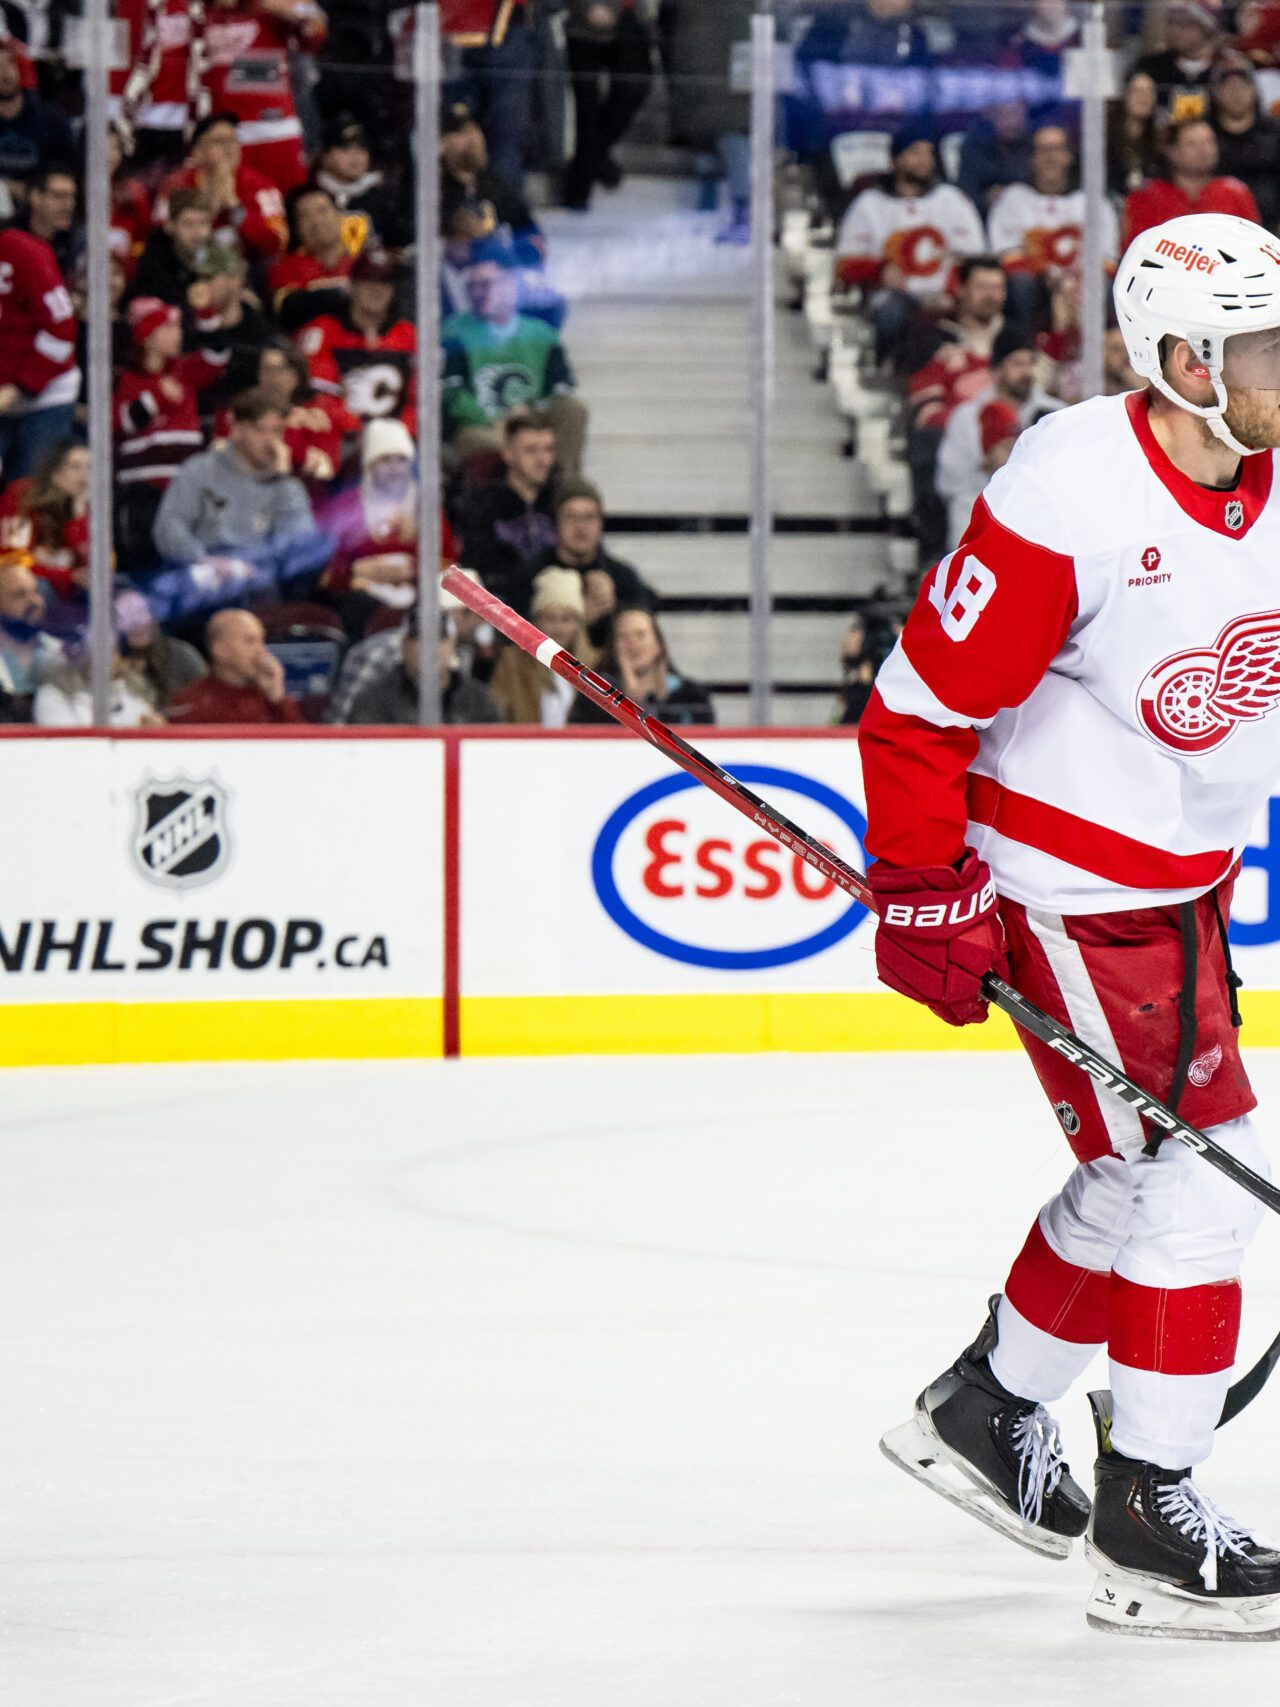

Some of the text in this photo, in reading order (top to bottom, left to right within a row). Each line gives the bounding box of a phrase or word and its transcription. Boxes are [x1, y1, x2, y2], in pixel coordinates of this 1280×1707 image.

[1155, 238, 1221, 275] meijer
[928, 544, 997, 643] 18
[1128, 573, 1172, 588] PRIORITY
[150, 798, 215, 870] NHL
[642, 819, 838, 901] Esso
